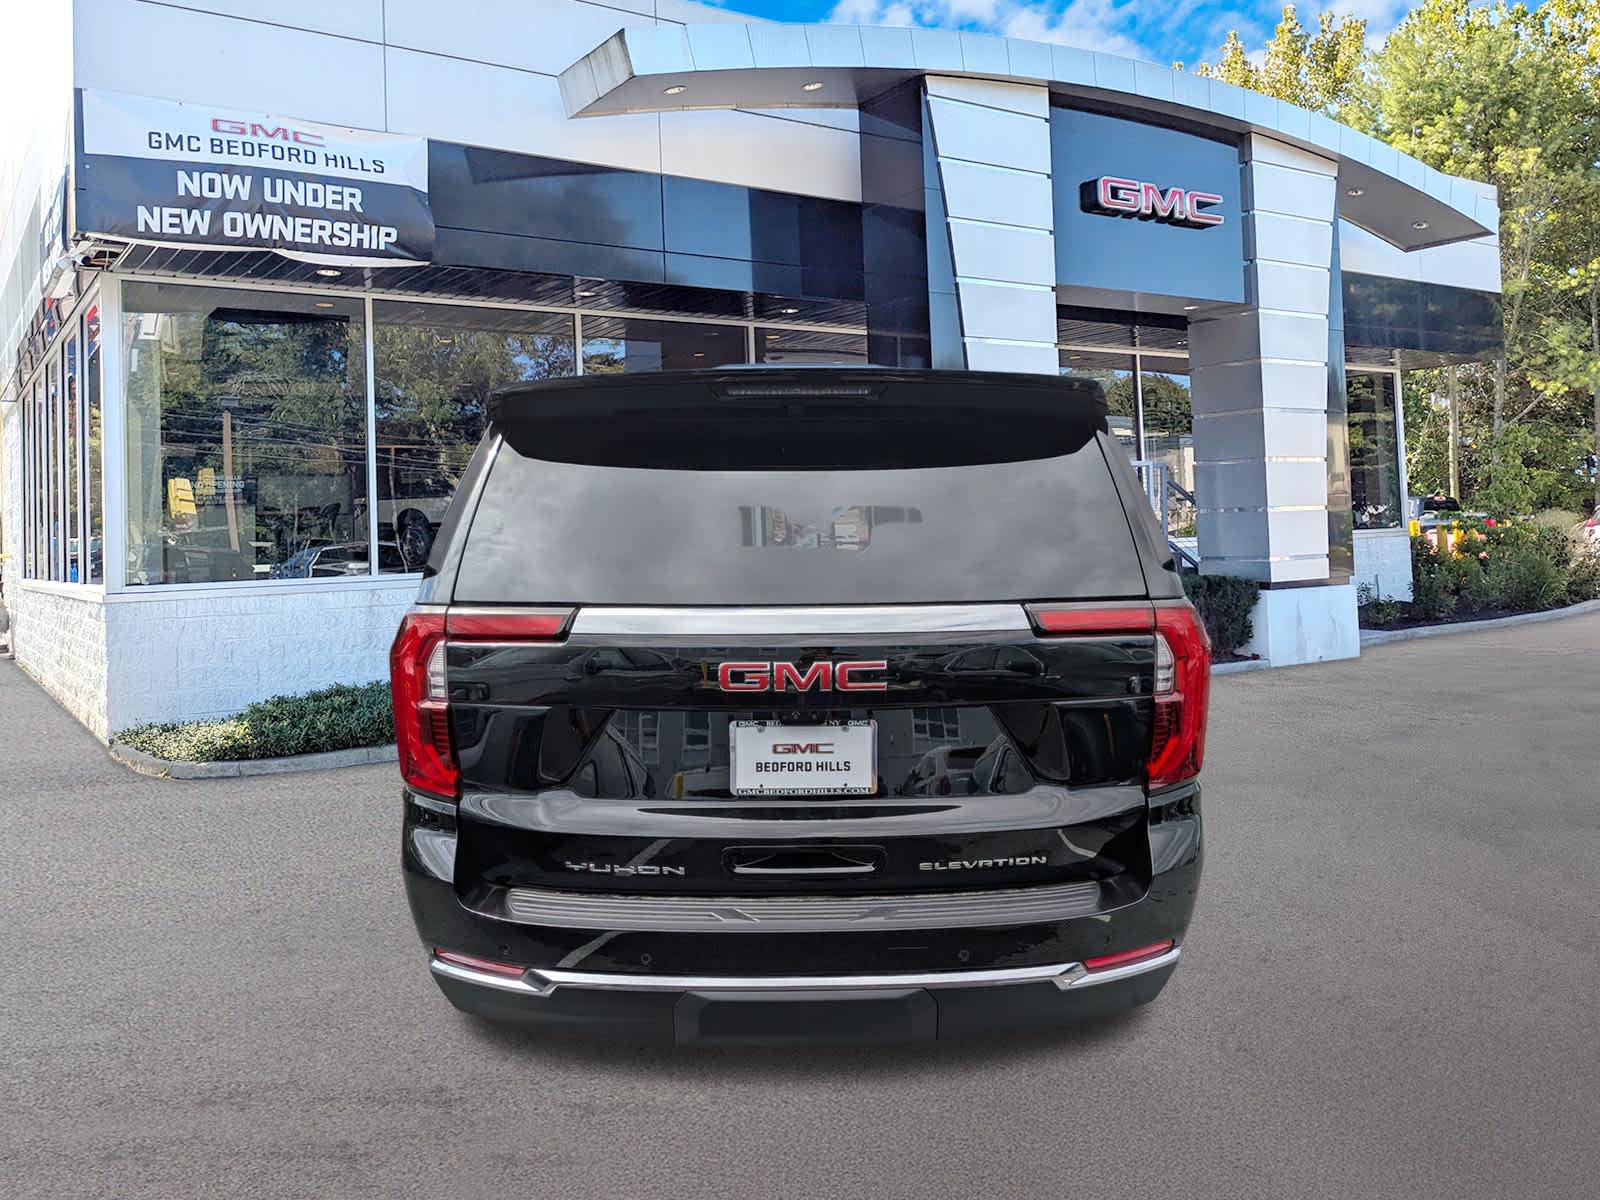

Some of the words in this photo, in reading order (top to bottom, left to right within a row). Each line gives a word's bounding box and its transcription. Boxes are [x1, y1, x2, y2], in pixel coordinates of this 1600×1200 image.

[211, 118, 325, 147] GMC
[148, 131, 201, 153] GMC
[210, 138, 316, 166] BEDFORD
[324, 152, 385, 174] HILLS
[176, 170, 252, 200] NOW
[263, 177, 363, 213] UNDER
[1096, 176, 1225, 225] GMC
[137, 205, 211, 236] NEW
[223, 211, 398, 250] OWNERSHIP
[718, 660, 888, 692] GMC
[772, 743, 834, 755] GMC
[755, 761, 812, 773] BEDFORD
[816, 760, 851, 772] HILLS
[738, 787, 869, 796] GMCBEDFORDHILLS.COM
[565, 860, 686, 877] YUKON
[919, 856, 1047, 871] ELEVATION
